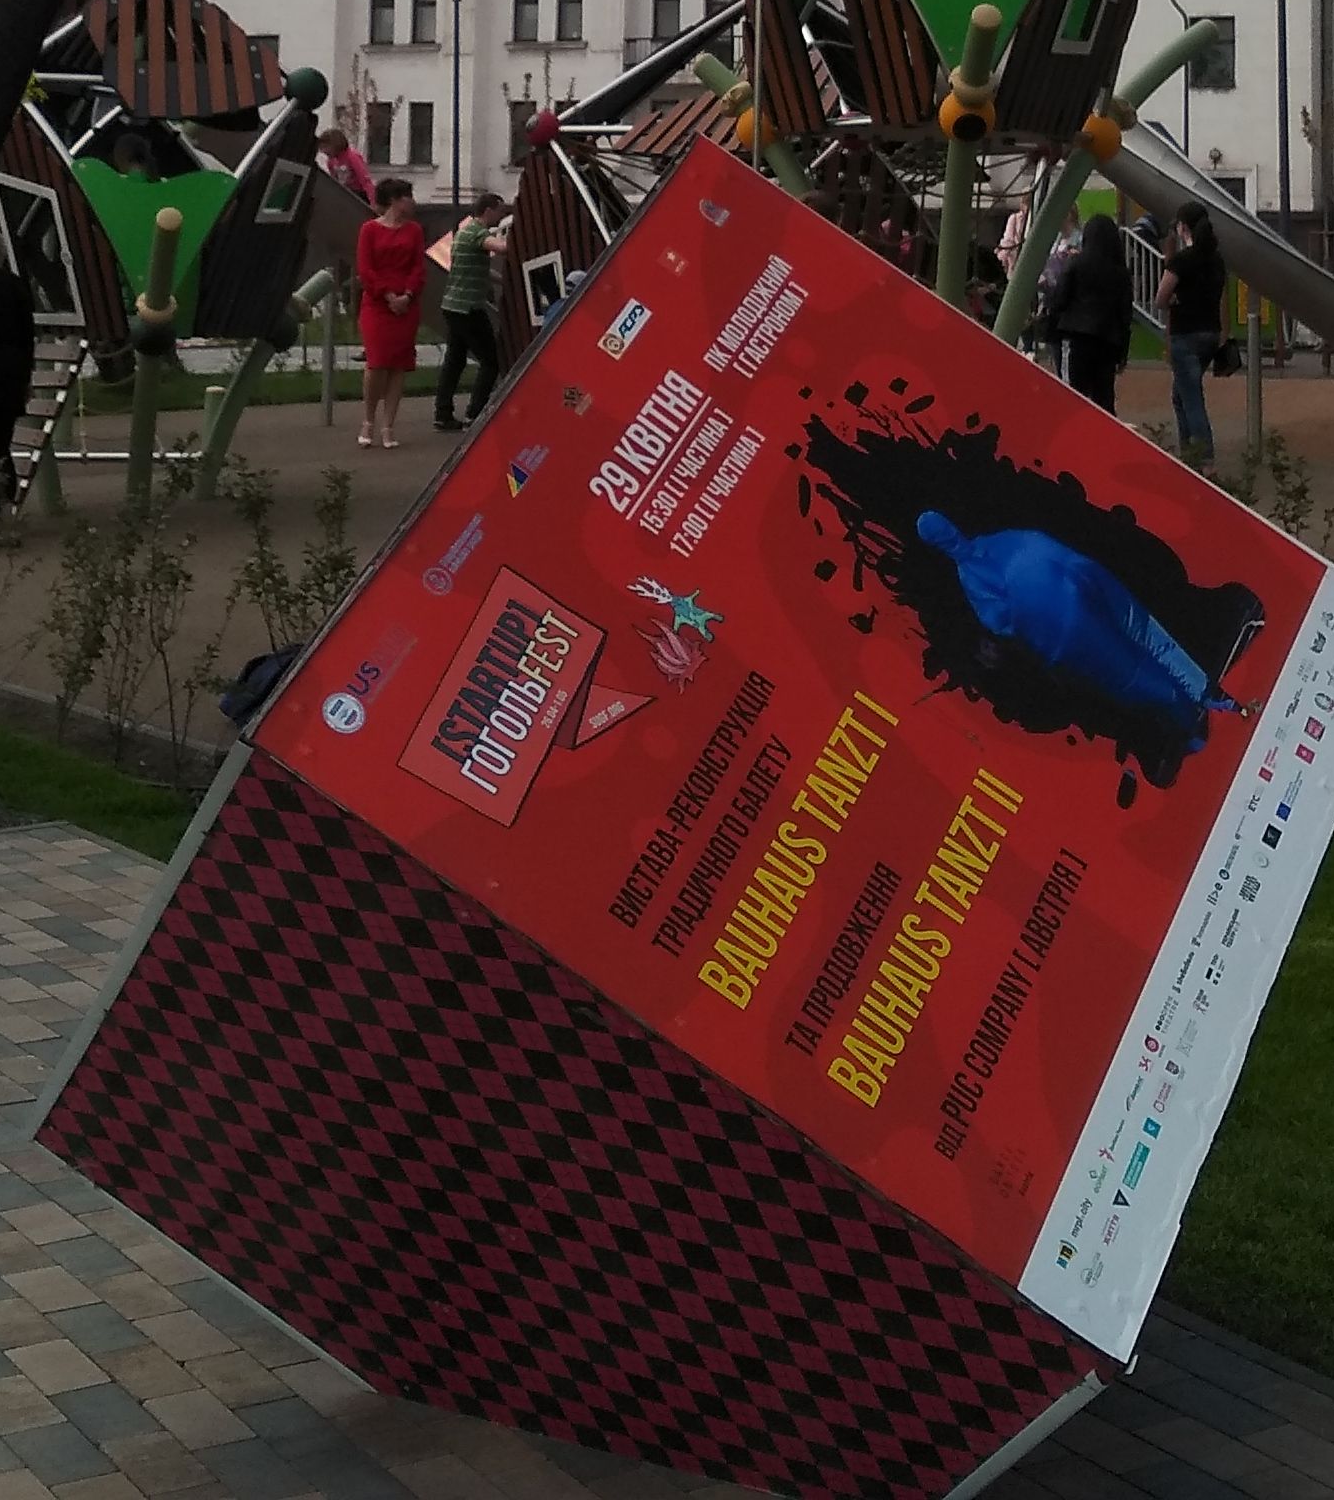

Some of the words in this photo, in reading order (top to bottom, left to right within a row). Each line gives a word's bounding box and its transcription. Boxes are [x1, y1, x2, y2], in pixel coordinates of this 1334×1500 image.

[701, 342, 733, 373] ПК
[714, 252, 794, 354] МОЛОДІЖНИЙ
[737, 286, 804, 372] ГАСТРОНОМ
[611, 367, 704, 476] КВІТНЯ
[636, 488, 679, 537] 15:30
[673, 414, 729, 483] ЧАСТИНА
[585, 457, 643, 514] 29
[668, 511, 709, 559] 17:00
[706, 432, 760, 501] ЧАСТИНА
[607, 668, 776, 931] ВИСТАВА-РЕКОНСТРУКЦІЯ
[650, 810, 753, 962] ТРІАДИЧНОГО
[729, 732, 795, 822] БАЛЕТУ
[696, 817, 830, 1010] BAUHAUS
[790, 705, 890, 838] TANZT
[1017, 859, 1082, 959] АВСТРІЯ
[800, 859, 904, 1030] ПРОДОВЖЕННЯ
[825, 909, 954, 1108] BAUHAUS
[913, 793, 1011, 931] TANZT
[971, 766, 1024, 814] II
[784, 1017, 823, 1060] ТА
[961, 960, 1035, 1082] COMPANY
[939, 1068, 986, 1129] PUC
